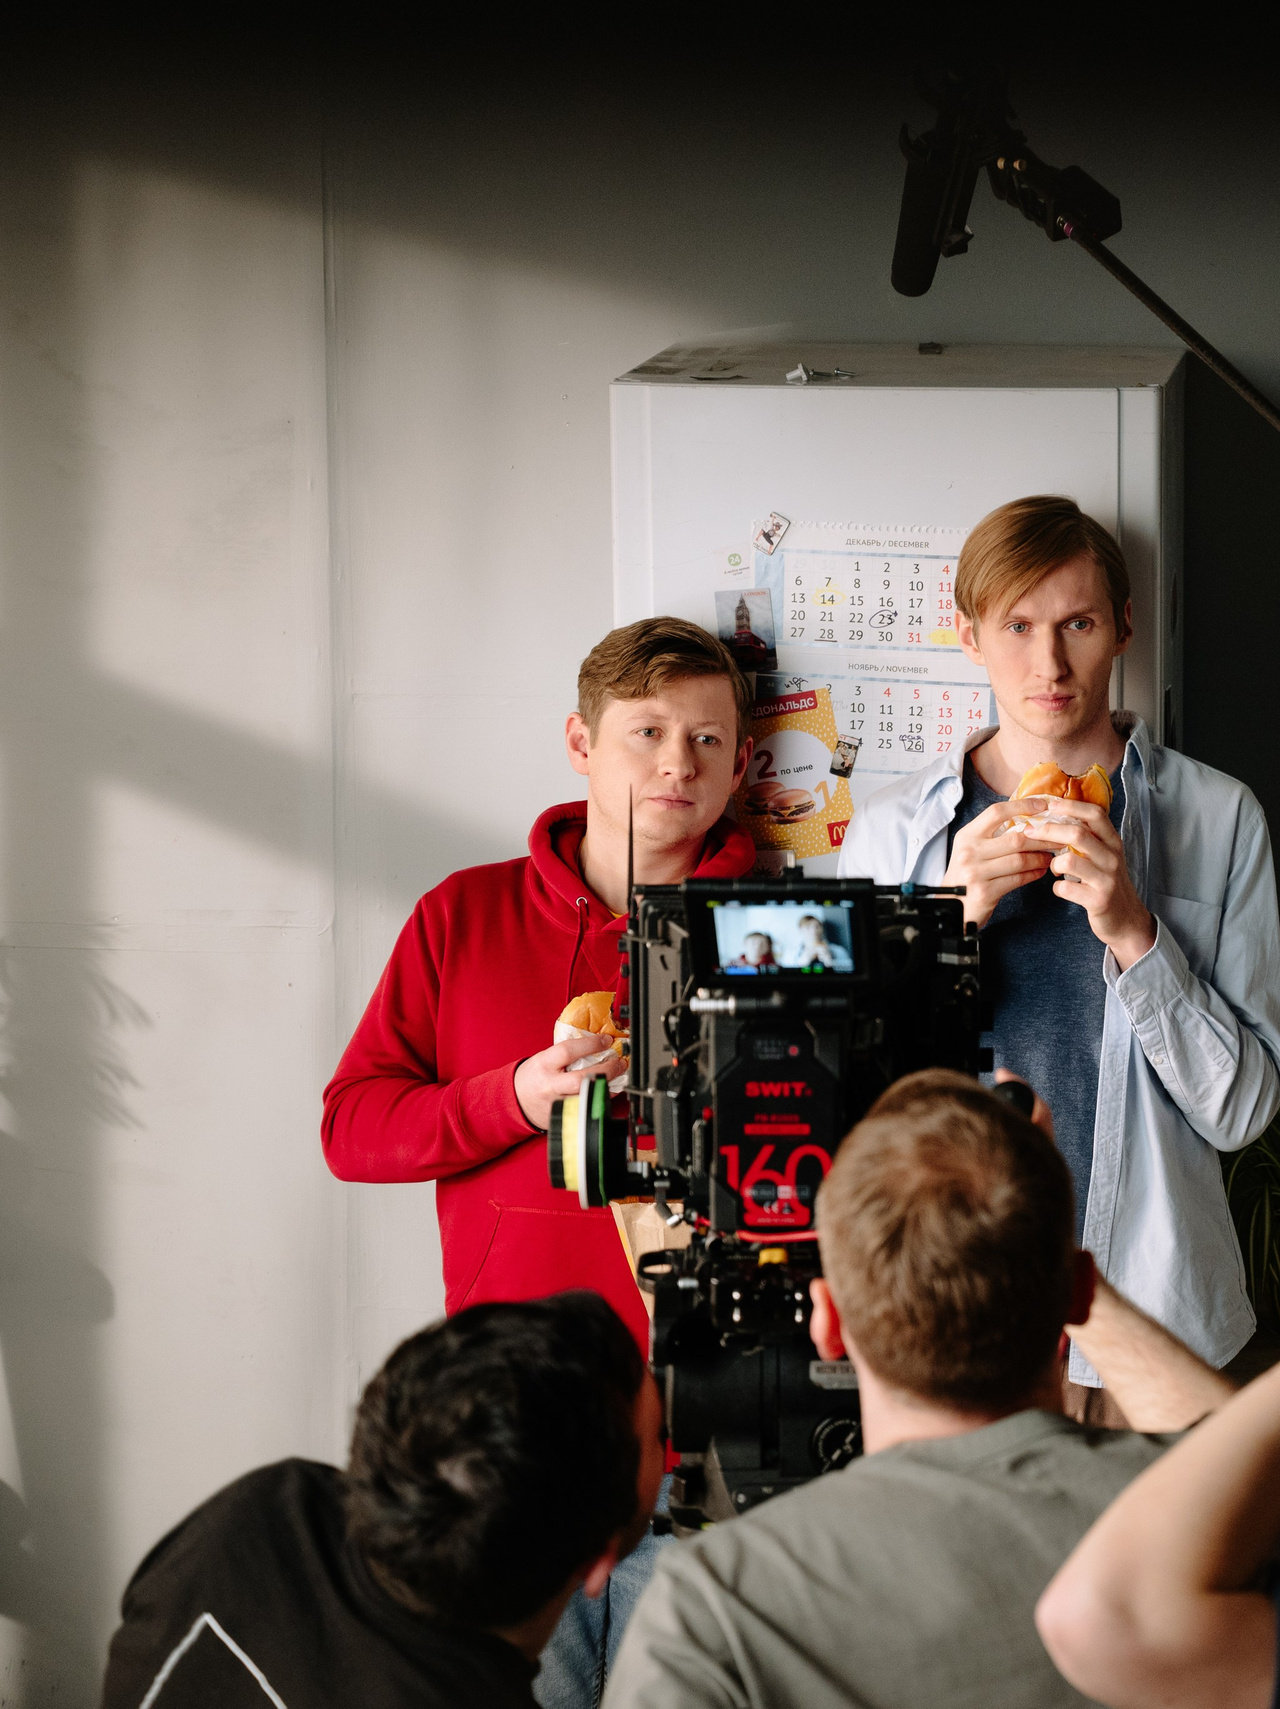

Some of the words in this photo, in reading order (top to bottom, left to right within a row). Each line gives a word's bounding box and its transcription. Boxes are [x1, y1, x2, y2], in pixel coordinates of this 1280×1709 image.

[845, 538, 880, 546] ДЕКАБРЬ
[888, 540, 929, 548] DECEMBER
[729, 556, 741, 565] 24
[855, 561, 861, 571] 1
[884, 563, 890, 572] 2
[914, 564, 919, 573] 3
[943, 565, 949, 574] 4
[795, 576, 802, 585] 6
[826, 577, 831, 587] 7
[854, 579, 860, 588] 8
[883, 580, 890, 589] 9
[909, 581, 923, 591] 10
[939, 582, 952, 592] 11
[792, 593, 805, 603] 13
[821, 595, 834, 605] 14
[850, 596, 863, 606] 15
[880, 597, 893, 607] 16
[909, 598, 923, 608] 17
[938, 599, 952, 609] 18
[791, 610, 805, 620] 20
[820, 612, 833, 622] 21
[850, 613, 863, 623] 22
[879, 614, 893, 625] 23
[908, 615, 922, 625] 24
[938, 616, 952, 627] 25
[791, 627, 804, 637] 27
[820, 629, 834, 639] 28
[849, 630, 863, 640] 29
[879, 632, 892, 641] 30
[908, 633, 921, 642] 31
[848, 663, 879, 671] НОЯБРЬ
[886, 665, 929, 674] NOVEMBER
[855, 686, 861, 695] 3
[884, 688, 891, 697] 4
[914, 689, 919, 699] 5
[943, 691, 949, 700] 6
[973, 692, 979, 701] 7
[851, 703, 864, 713] 10
[880, 705, 893, 714] 11
[909, 706, 922, 716] 12
[939, 708, 952, 718] 13
[968, 710, 982, 719] 14
[851, 720, 864, 729] 17
[880, 722, 893, 732] 18
[908, 723, 923, 733] 19
[938, 725, 952, 735] 20
[878, 739, 891, 749] 25
[907, 740, 922, 751] 26
[937, 742, 951, 751] 27
[754, 749, 778, 780] 2
[793, 764, 814, 773] цене
[813, 779, 831, 807] 1
[745, 1081, 807, 1098] SWIT
[719, 1144, 833, 1220] 160
